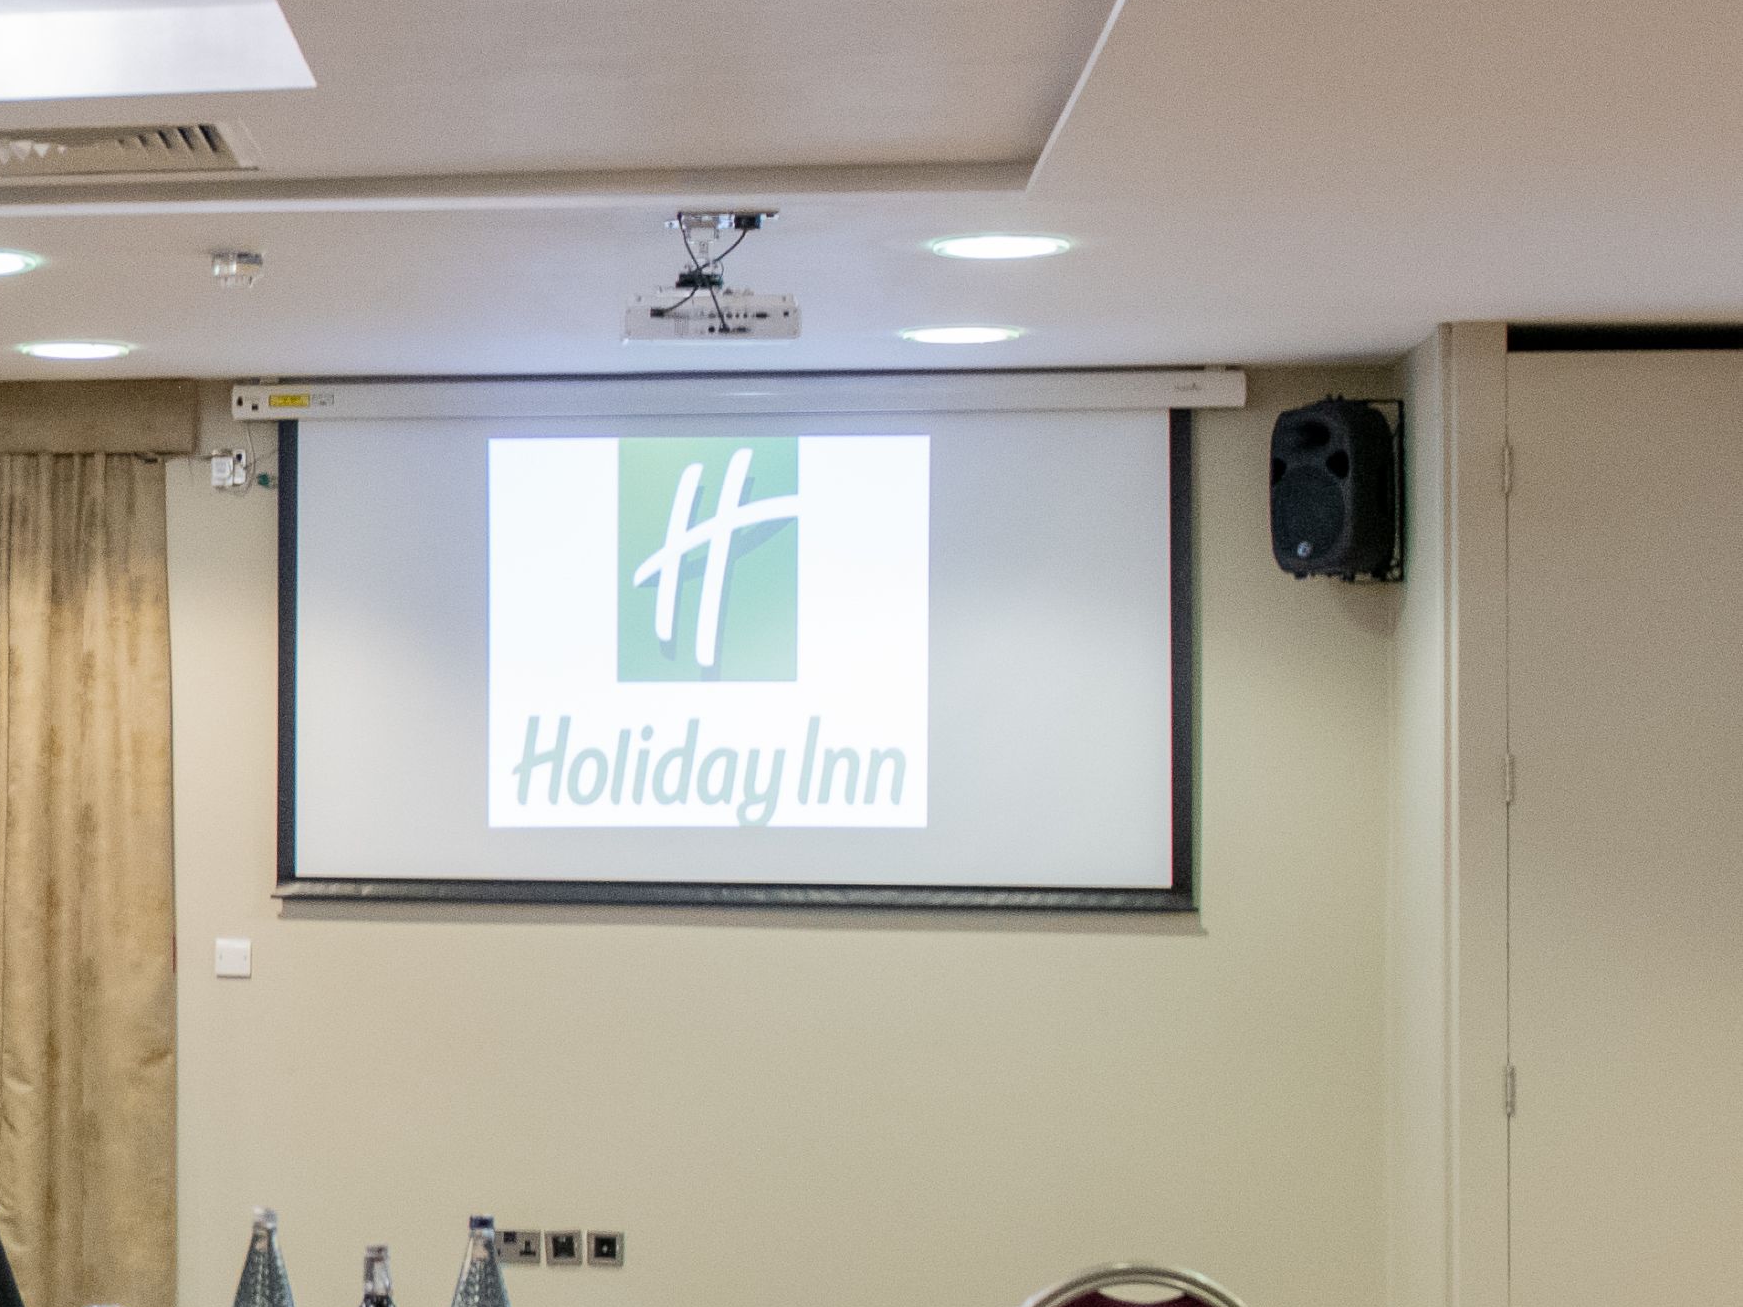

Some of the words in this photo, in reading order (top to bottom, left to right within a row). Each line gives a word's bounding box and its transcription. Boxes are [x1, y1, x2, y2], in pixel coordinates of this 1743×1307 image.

[633, 447, 799, 667] H
[512, 715, 787, 827] Holiday
[797, 715, 907, 806] Inn
